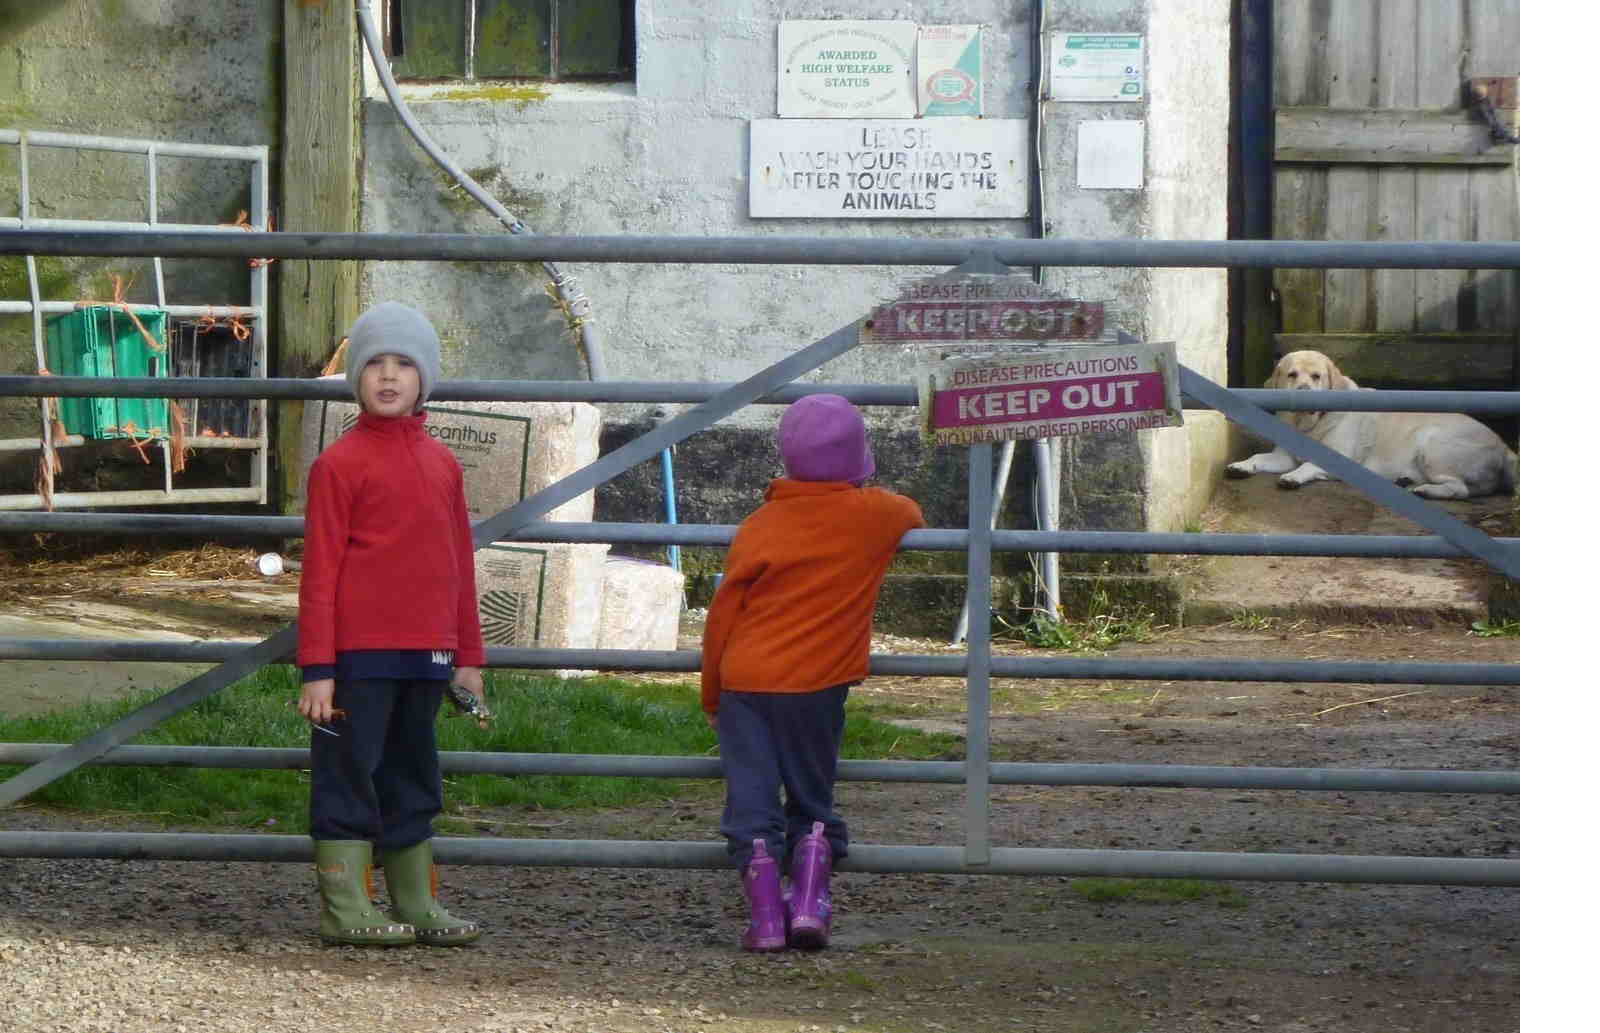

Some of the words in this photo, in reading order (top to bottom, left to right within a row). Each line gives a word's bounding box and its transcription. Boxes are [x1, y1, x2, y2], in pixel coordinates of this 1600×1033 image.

[818, 50, 877, 60] AWARDED
[801, 64, 832, 74] HIGH
[837, 64, 893, 74] WELFARE
[824, 78, 871, 88] STATUS
[845, 151, 907, 170] YOUR
[779, 171, 840, 190] FTER
[959, 171, 997, 190] THE
[842, 192, 937, 210] ANIMALS
[899, 307, 992, 333] KEEP
[953, 366, 1019, 386] DISEASE
[1023, 355, 1138, 380] PRECAUTIONS
[959, 388, 1051, 419] KEEP
[1061, 380, 1140, 410] OUT
[963, 421, 1079, 444] UNAUTHORISED
[1081, 414, 1168, 433] PERSONNEL
